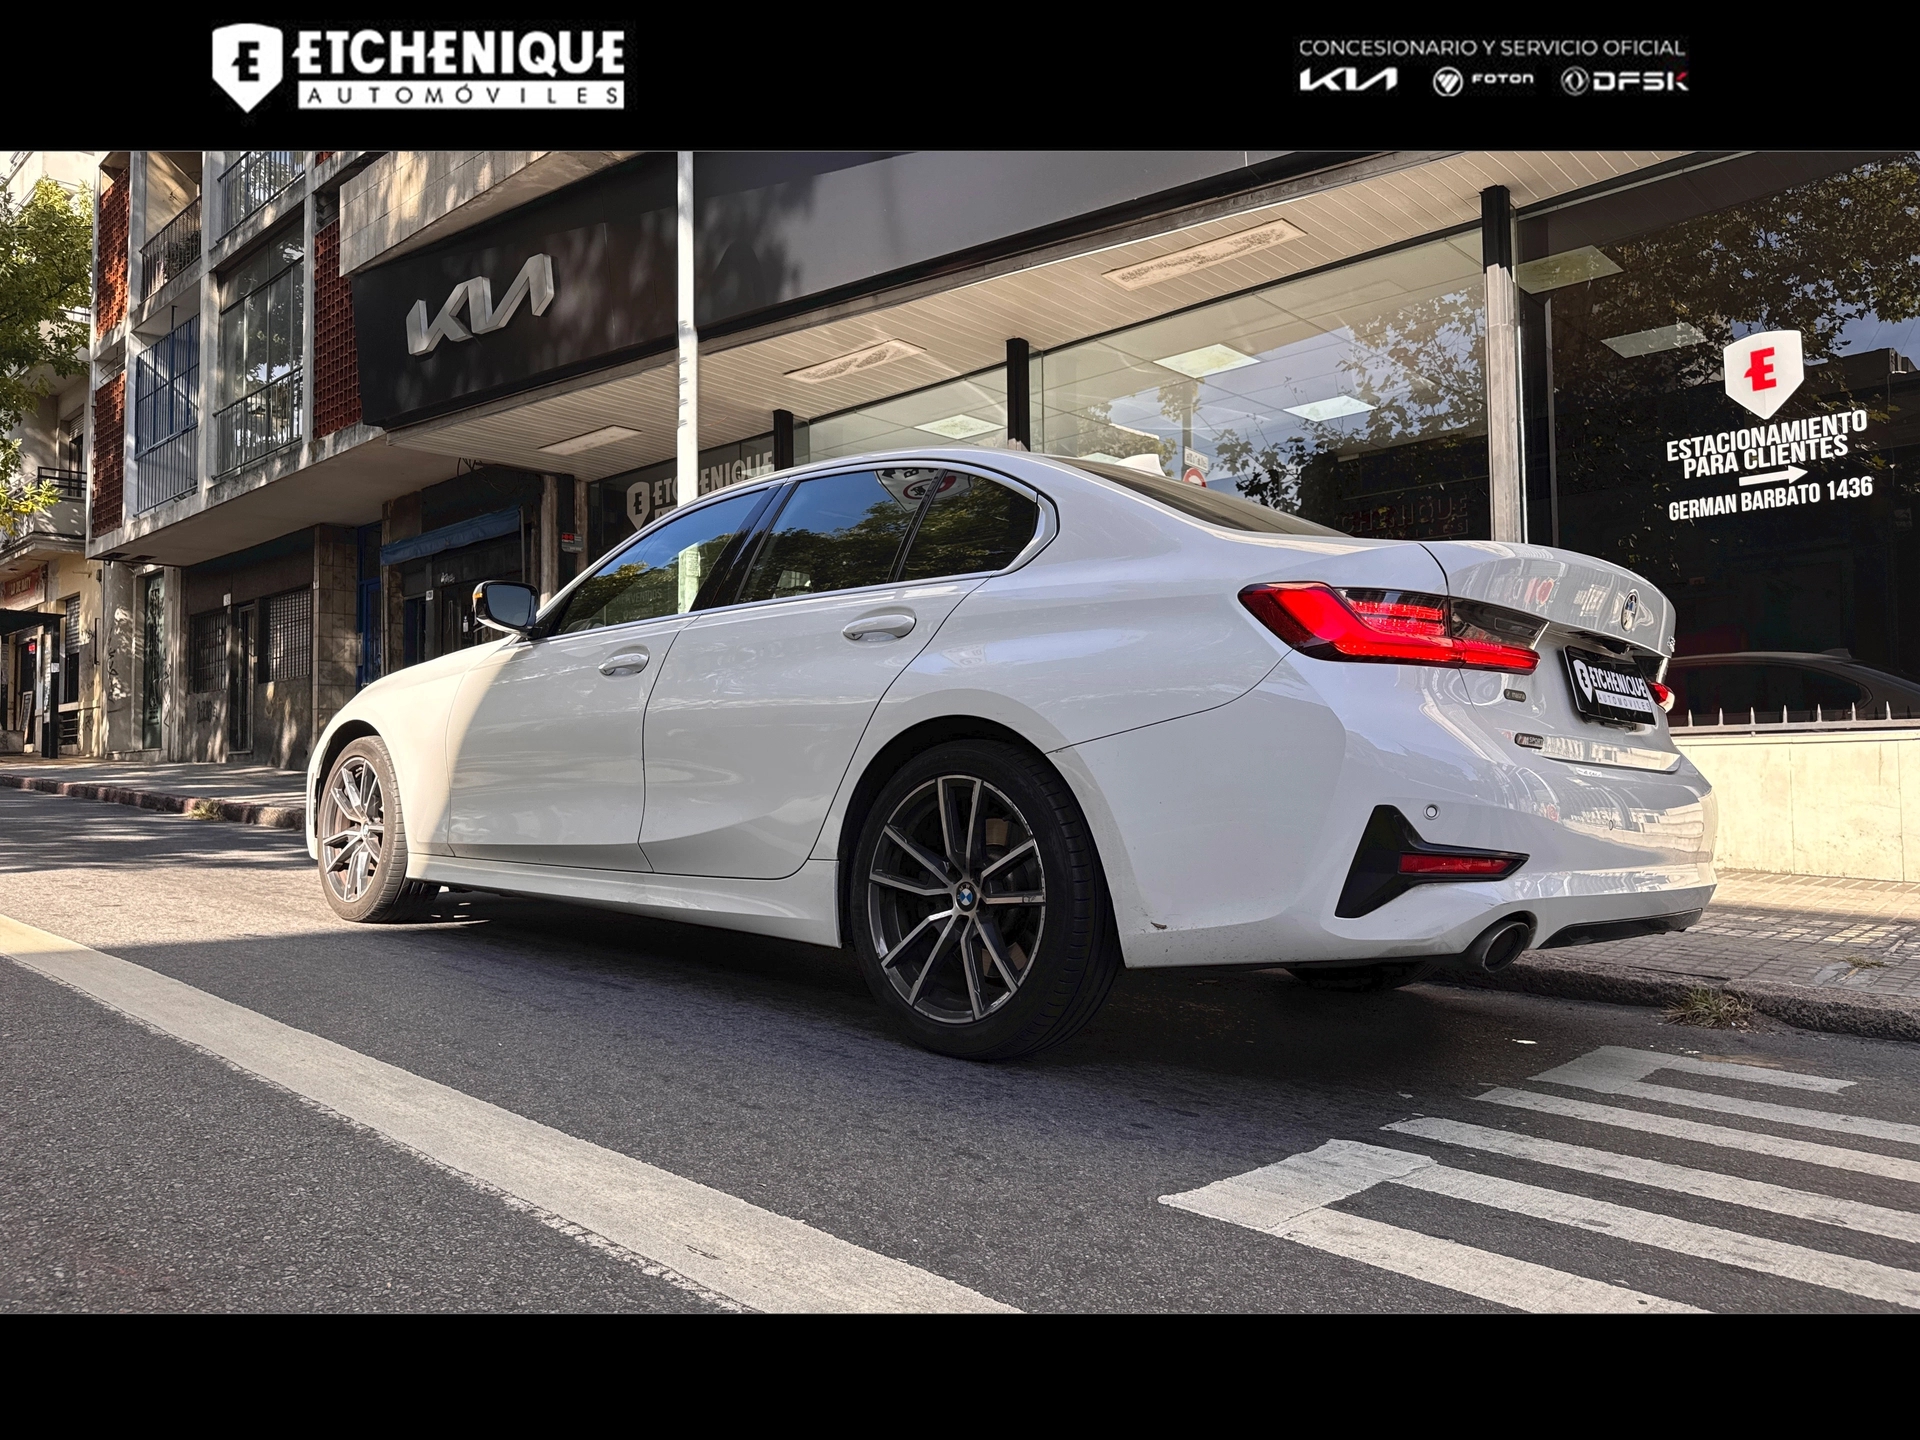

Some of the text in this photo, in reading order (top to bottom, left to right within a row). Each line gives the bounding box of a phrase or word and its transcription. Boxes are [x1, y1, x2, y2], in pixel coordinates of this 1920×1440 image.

[1666, 409, 1868, 462] ESTACIONAMIENTO
[1683, 434, 1849, 479] PARA CLIENTES
[1668, 475, 1873, 521] GERMAN BARBATO 1436
[1587, 665, 1648, 698] ETCHENIQUE
